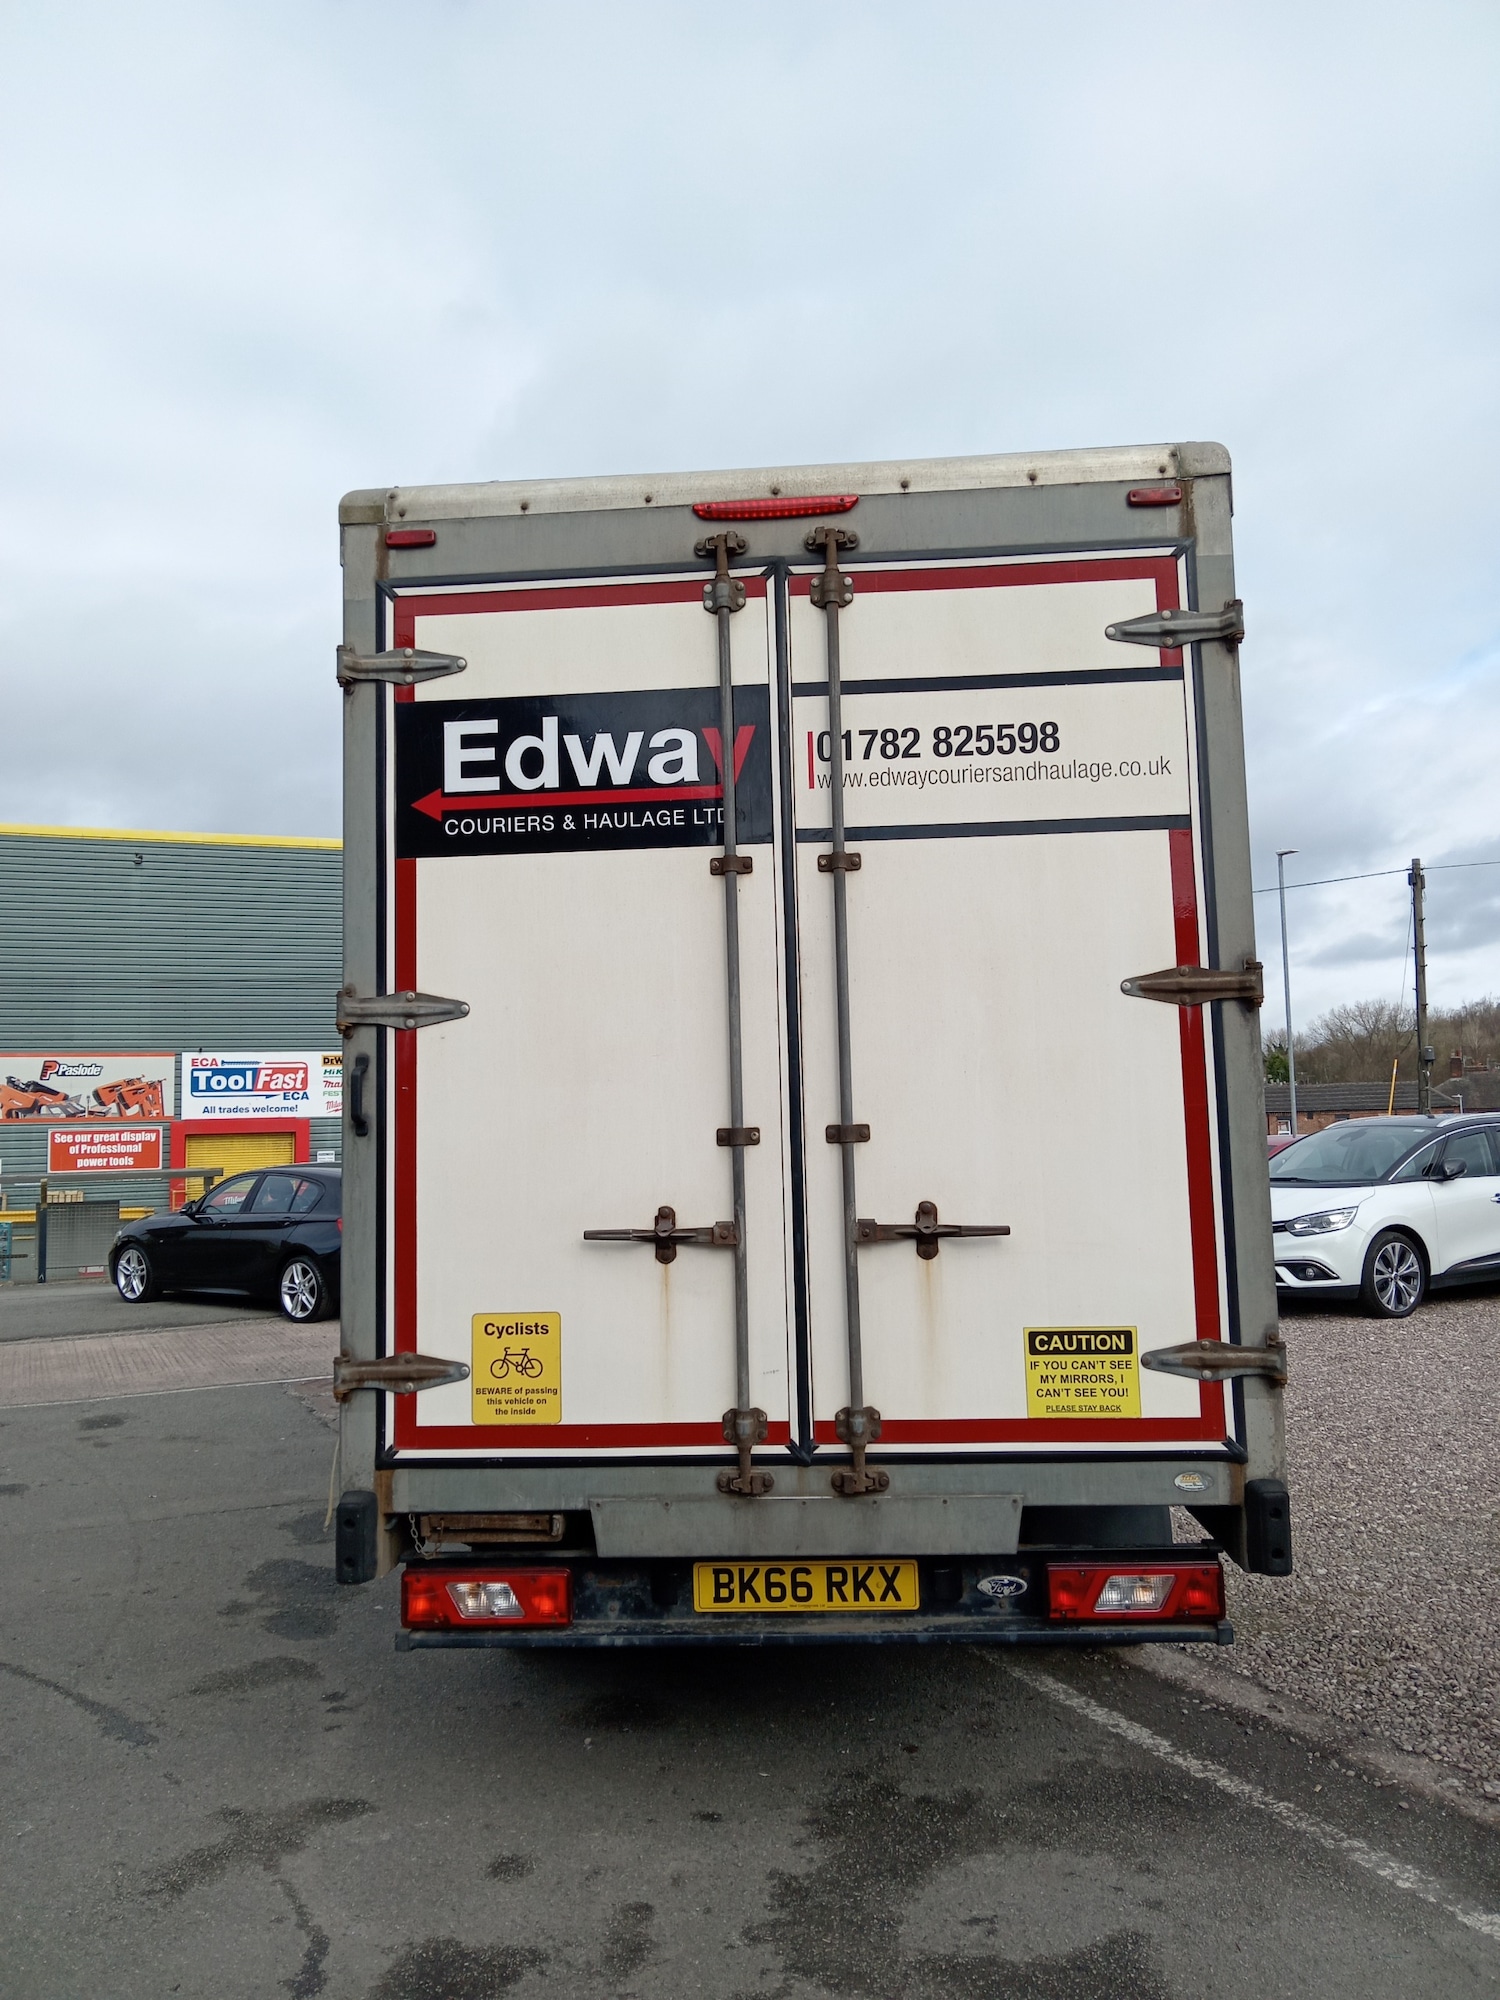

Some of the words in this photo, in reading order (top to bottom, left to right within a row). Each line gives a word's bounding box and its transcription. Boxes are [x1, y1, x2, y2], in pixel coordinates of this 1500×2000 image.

[817, 727, 921, 762] 01782
[933, 721, 1060, 757] 825598
[443, 716, 756, 793] Edway
[817, 755, 1172, 789] ww.edwaycouriersandhaulage.co.uk
[444, 815, 555, 836] COURIERS
[563, 814, 576, 830] &
[584, 809, 685, 830] HAULAGE
[191, 1058, 219, 1067] ECA
[58, 1063, 103, 1077] Paslode
[283, 1091, 309, 1101] ECA
[202, 1106, 216, 1114] All
[218, 1105, 249, 1114] trades
[252, 1104, 298, 1113] welcome!
[54, 1133, 73, 1143] See
[75, 1134, 92, 1143] our
[93, 1133, 120, 1144] great
[121, 1131, 157, 1143] display
[69, 1145, 79, 1154] of
[81, 1143, 142, 1154] Professional
[77, 1158, 107, 1168] power
[109, 1156, 134, 1167] tools
[484, 1322, 550, 1339] Cyclists
[1035, 1334, 1126, 1351] CAUTION
[1030, 1361, 1040, 1370] IF
[1043, 1361, 1068, 1370] YOU
[1071, 1360, 1106, 1370] CAN'T
[1109, 1360, 1133, 1370] SEE
[1040, 1374, 1057, 1384] MY
[1060, 1374, 1118, 1385] MIRRORS,
[1120, 1374, 1124, 1383] I
[475, 1387, 512, 1395] BEWARE
[514, 1387, 523, 1395] of
[525, 1387, 558, 1396] passing
[1036, 1388, 1071, 1398] CAN'T
[1074, 1388, 1098, 1397] SEE
[1099, 1388, 1129, 1397] YOU!
[504, 1397, 534, 1405] vehicle
[1099, 1404, 1122, 1412] BACK
[712, 1567, 813, 1603] BK66
[826, 1566, 902, 1603] RKX
